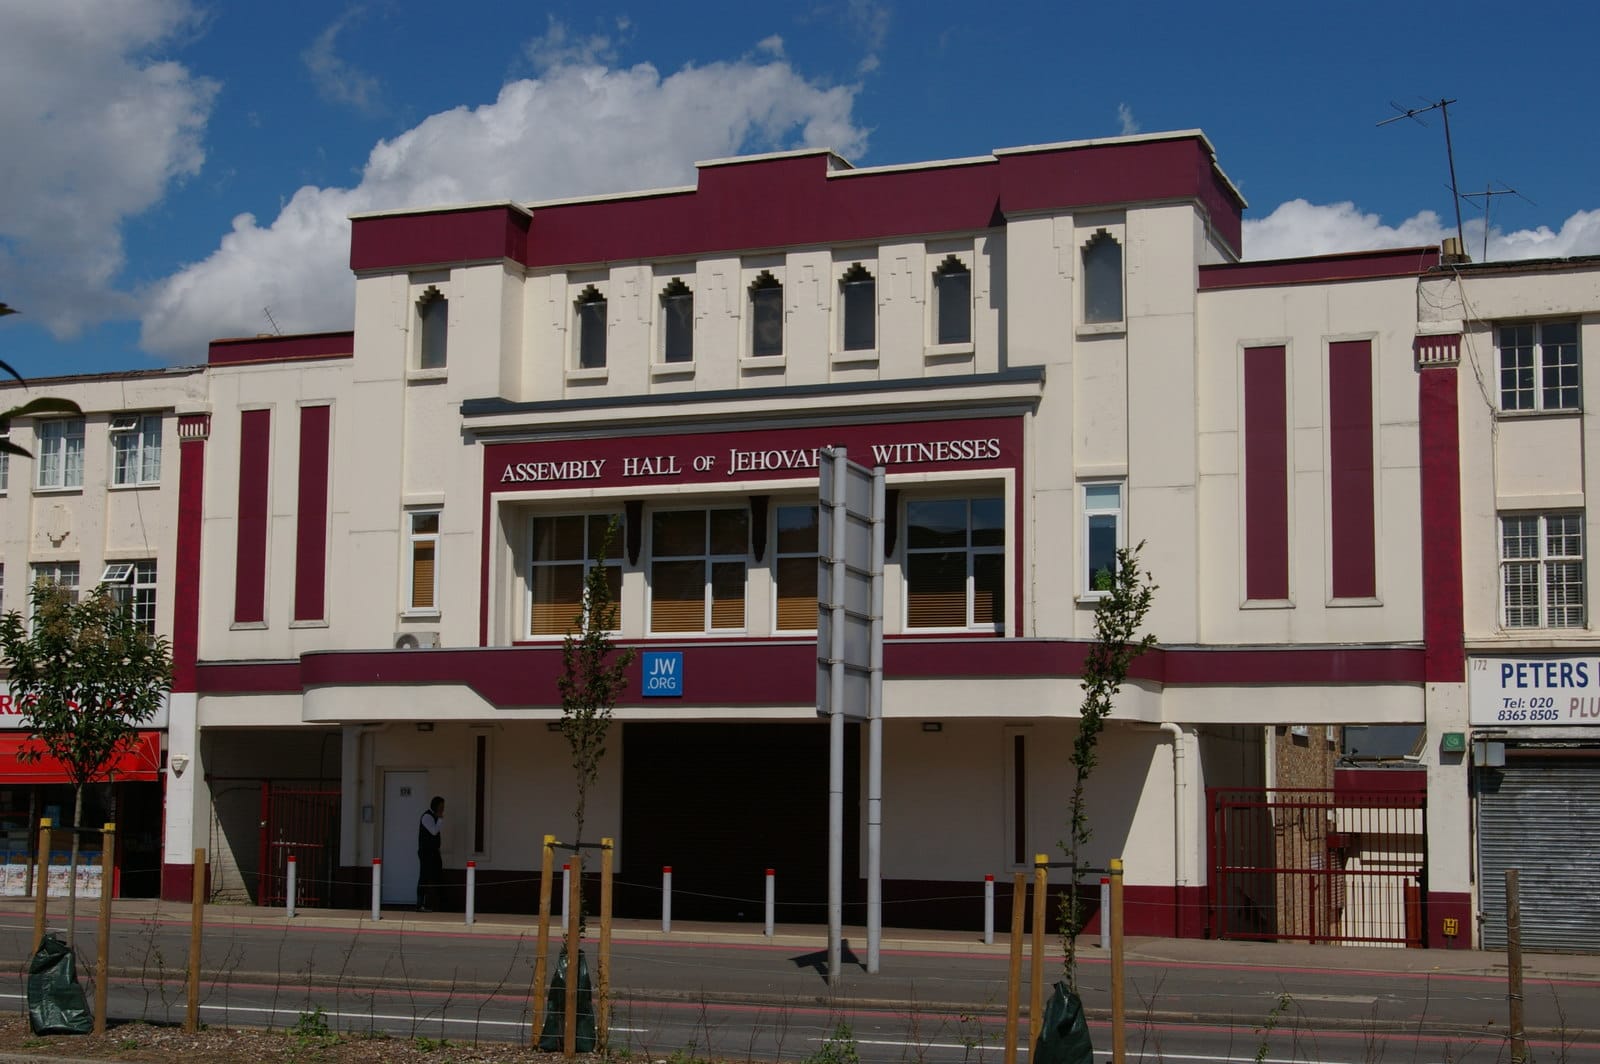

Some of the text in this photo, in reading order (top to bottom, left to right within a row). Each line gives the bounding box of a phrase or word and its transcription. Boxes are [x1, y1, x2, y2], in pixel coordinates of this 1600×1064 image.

[500, 438, 1000, 482] ASSEMBLY HALL OF JEHOVAH WITNESSES
[649, 658, 676, 675] JW
[1473, 660, 1488, 671] 172
[1501, 662, 1589, 689] PETERS
[648, 677, 676, 689] .ORG
[1503, 697, 1554, 708] Tel: 020
[1497, 709, 1559, 721] 8365 8505
